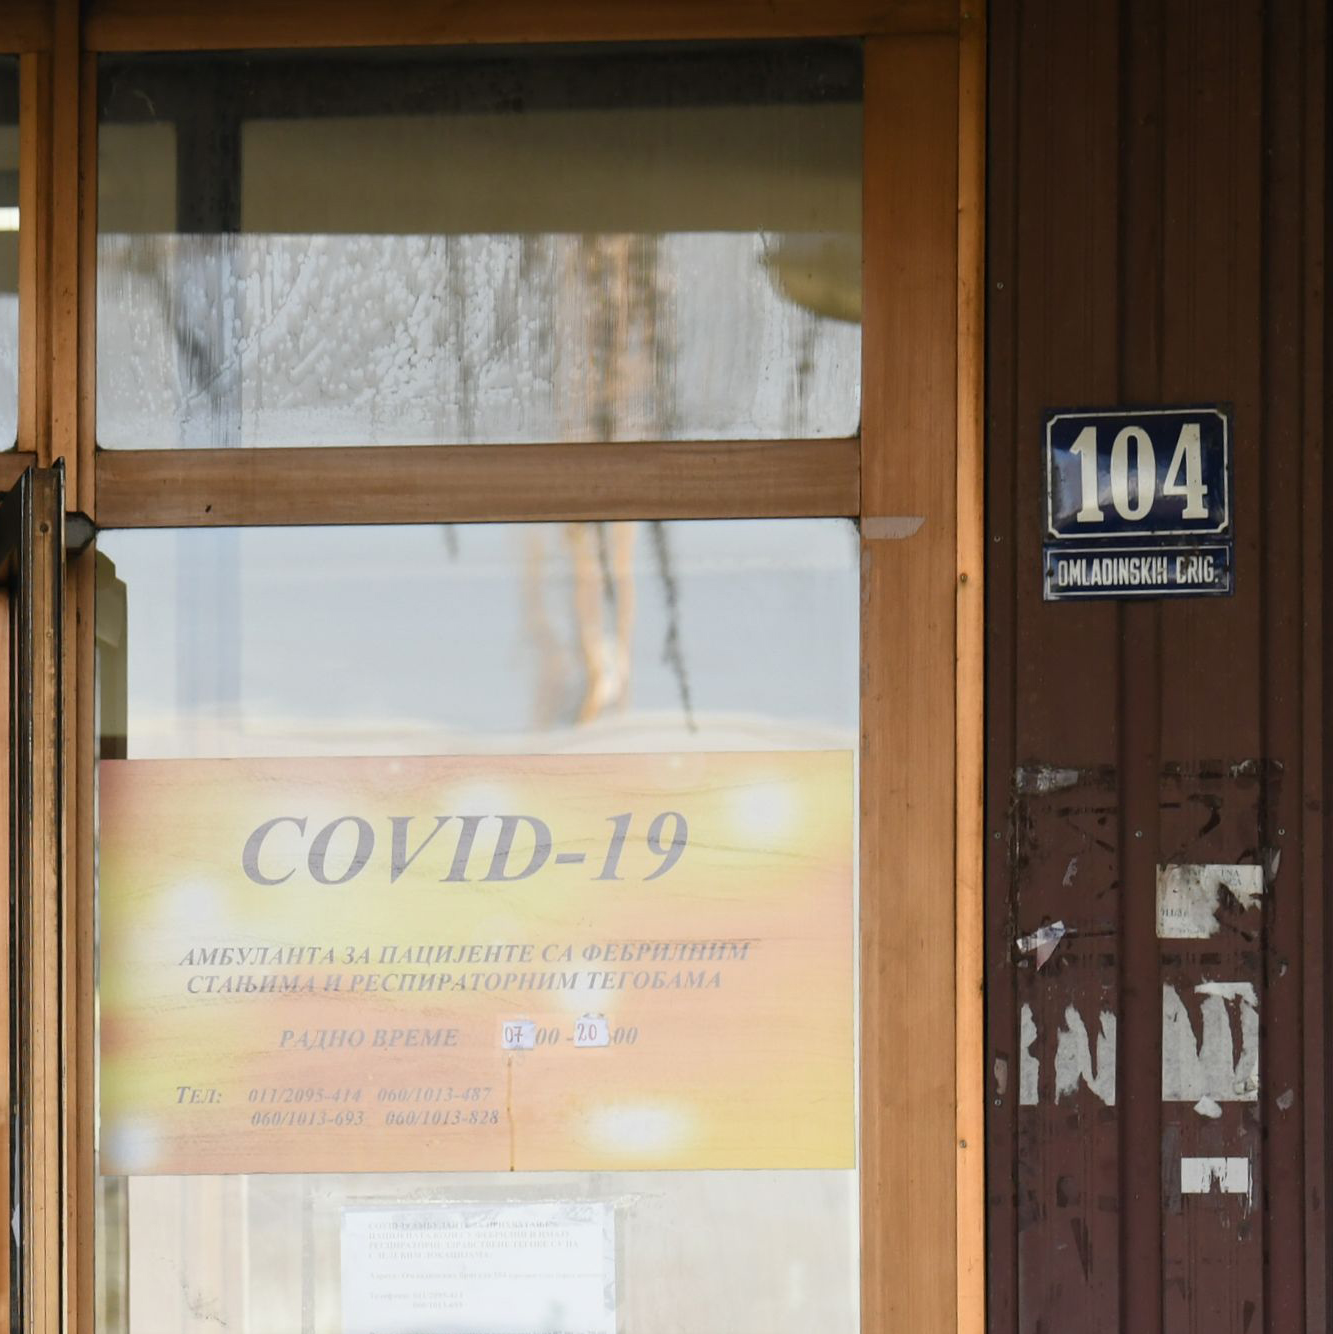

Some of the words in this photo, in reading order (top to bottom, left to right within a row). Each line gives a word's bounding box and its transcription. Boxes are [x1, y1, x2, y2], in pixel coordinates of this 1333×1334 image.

[1068, 423, 1209, 523] 104
[1057, 556, 1168, 587] OMLADINSKIH
[1175, 555, 1219, 584] BRIG.
[240, 810, 690, 886] COVID-19
[178, 946, 335, 966] АМБУЛАНТА
[341, 945, 371, 965] ЗА
[378, 944, 533, 966] ПАЦИЈЕНТЕ
[541, 944, 574, 963] СА
[582, 942, 751, 963] ФЕБРИЛНИМ
[186, 974, 315, 994] СТАЊИМА
[323, 974, 344, 993] И
[354, 971, 579, 994] РЕСПИРАТОРНИМ
[587, 970, 723, 991] ТЕГОБАМА
[278, 1029, 365, 1050] РАДНО
[371, 1028, 459, 1048] ВРЕМЕ
[377, 1087, 493, 1105] 060/1013-487
[251, 1110, 364, 1127] 060/1013-693
[385, 1110, 500, 1127] 060/1013-828
